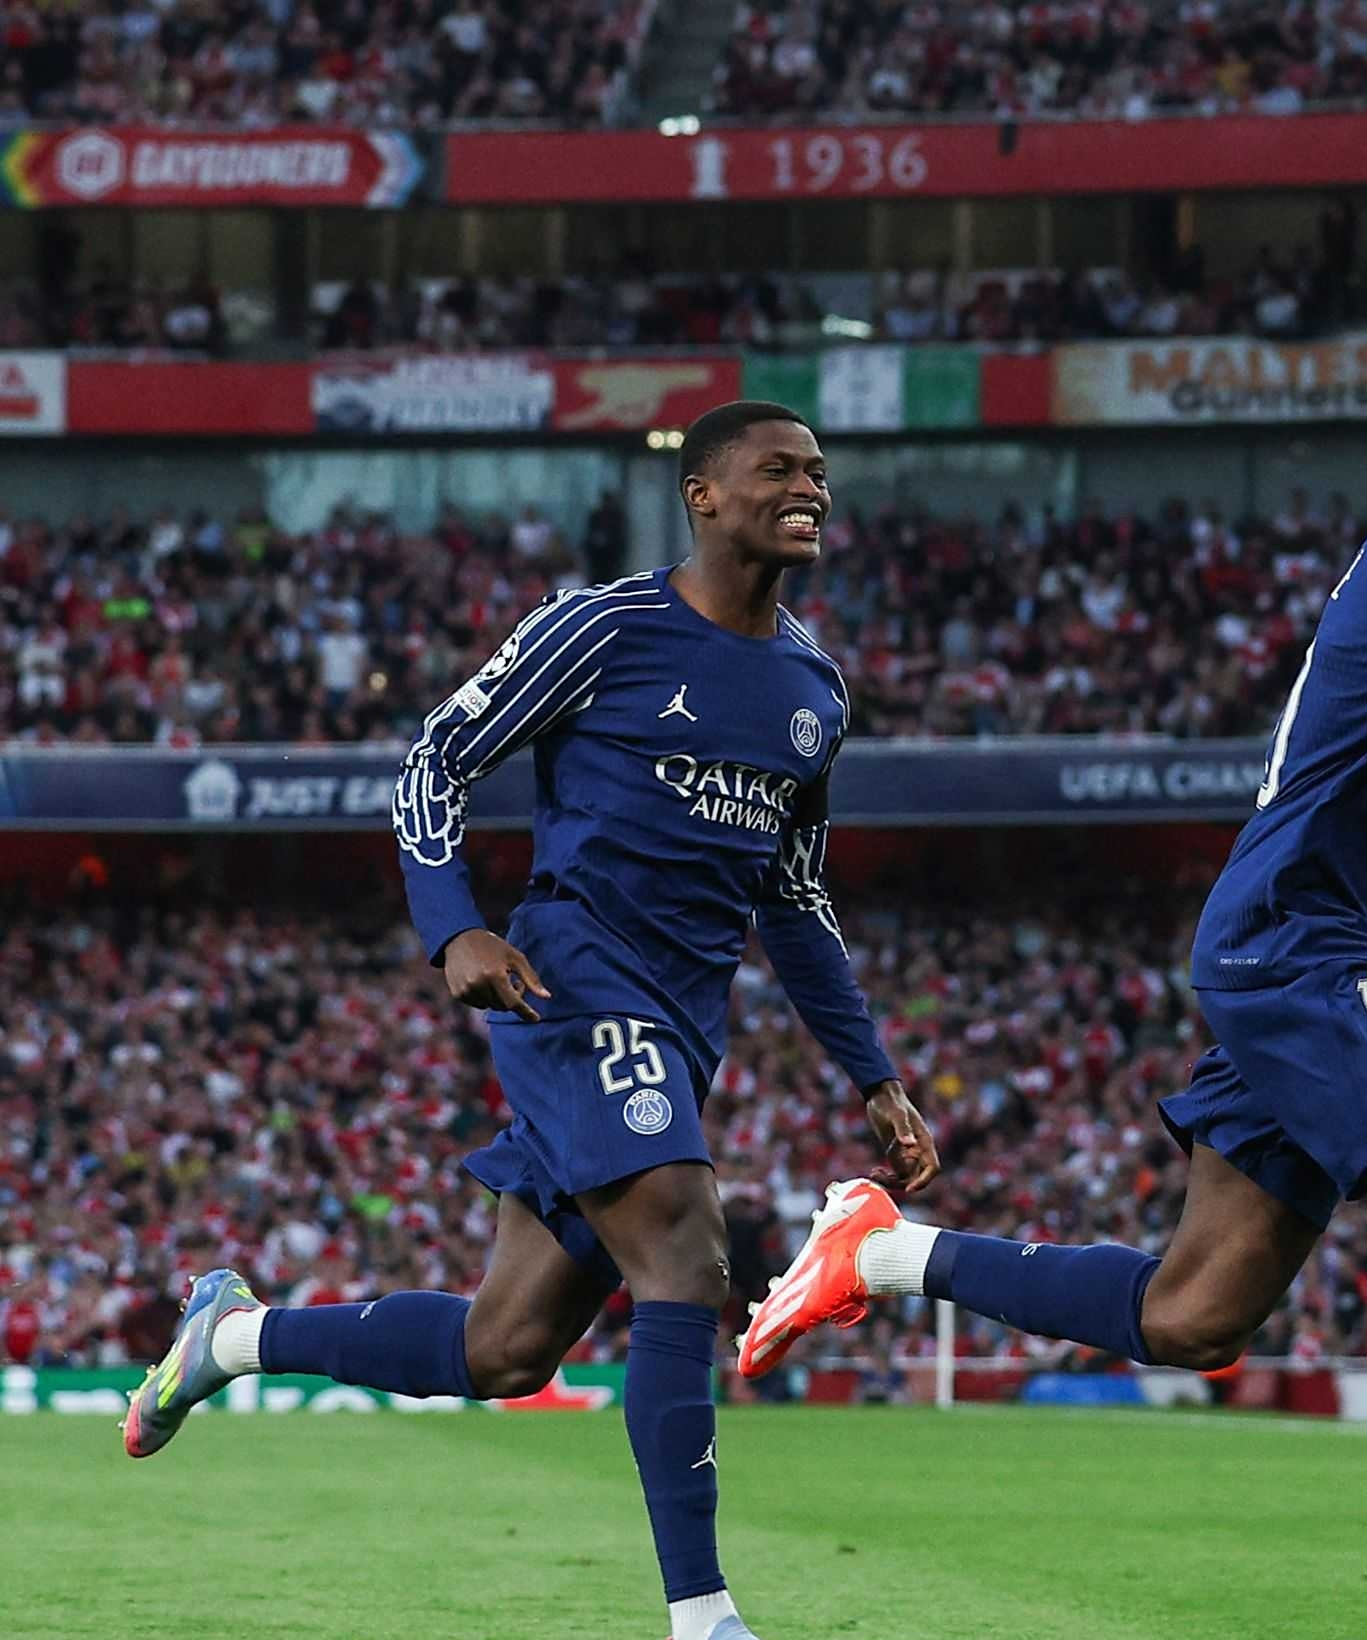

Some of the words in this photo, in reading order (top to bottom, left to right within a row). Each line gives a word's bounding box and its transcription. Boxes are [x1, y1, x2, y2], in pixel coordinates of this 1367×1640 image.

[772, 135, 928, 192] 1936
[248, 777, 338, 817] JUST
[655, 754, 799, 812] QATAR
[1060, 763, 1161, 801] UEFA
[688, 794, 780, 834] AIRWAYS
[591, 1018, 667, 1095] 25
